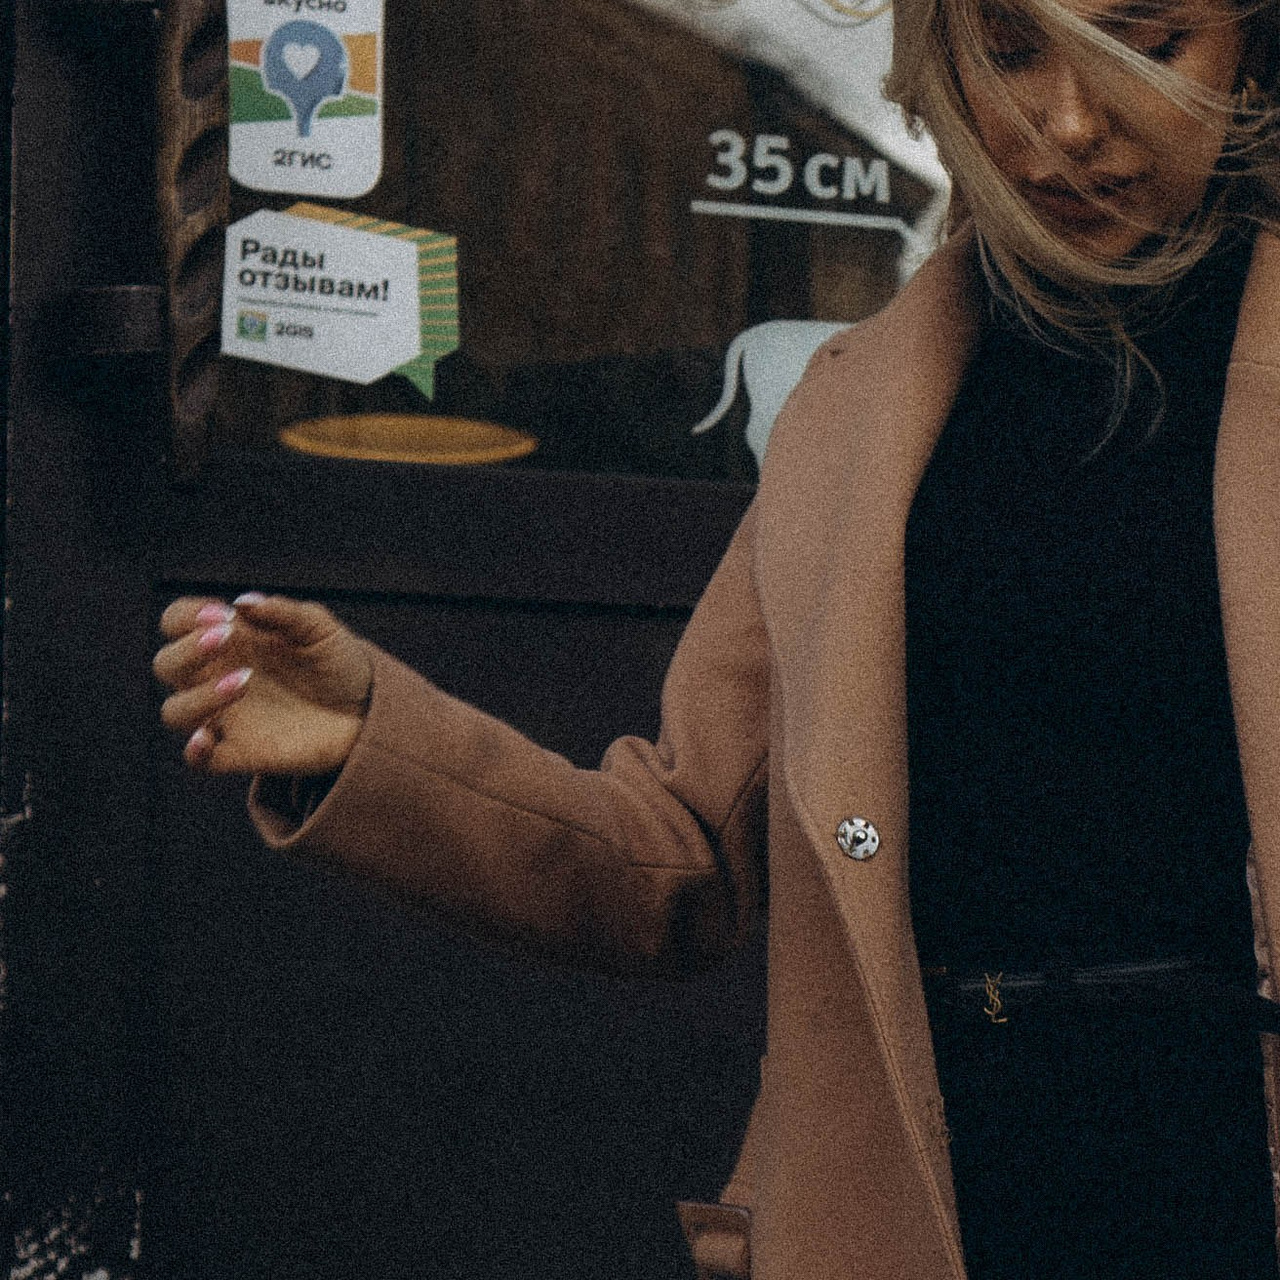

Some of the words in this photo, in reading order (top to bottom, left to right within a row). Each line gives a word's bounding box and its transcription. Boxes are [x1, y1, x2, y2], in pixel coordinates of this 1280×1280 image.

[271, 148, 333, 171] 2ГИС
[705, 128, 795, 196] 35
[239, 237, 326, 271] Рады
[237, 269, 390, 302] отзывам!
